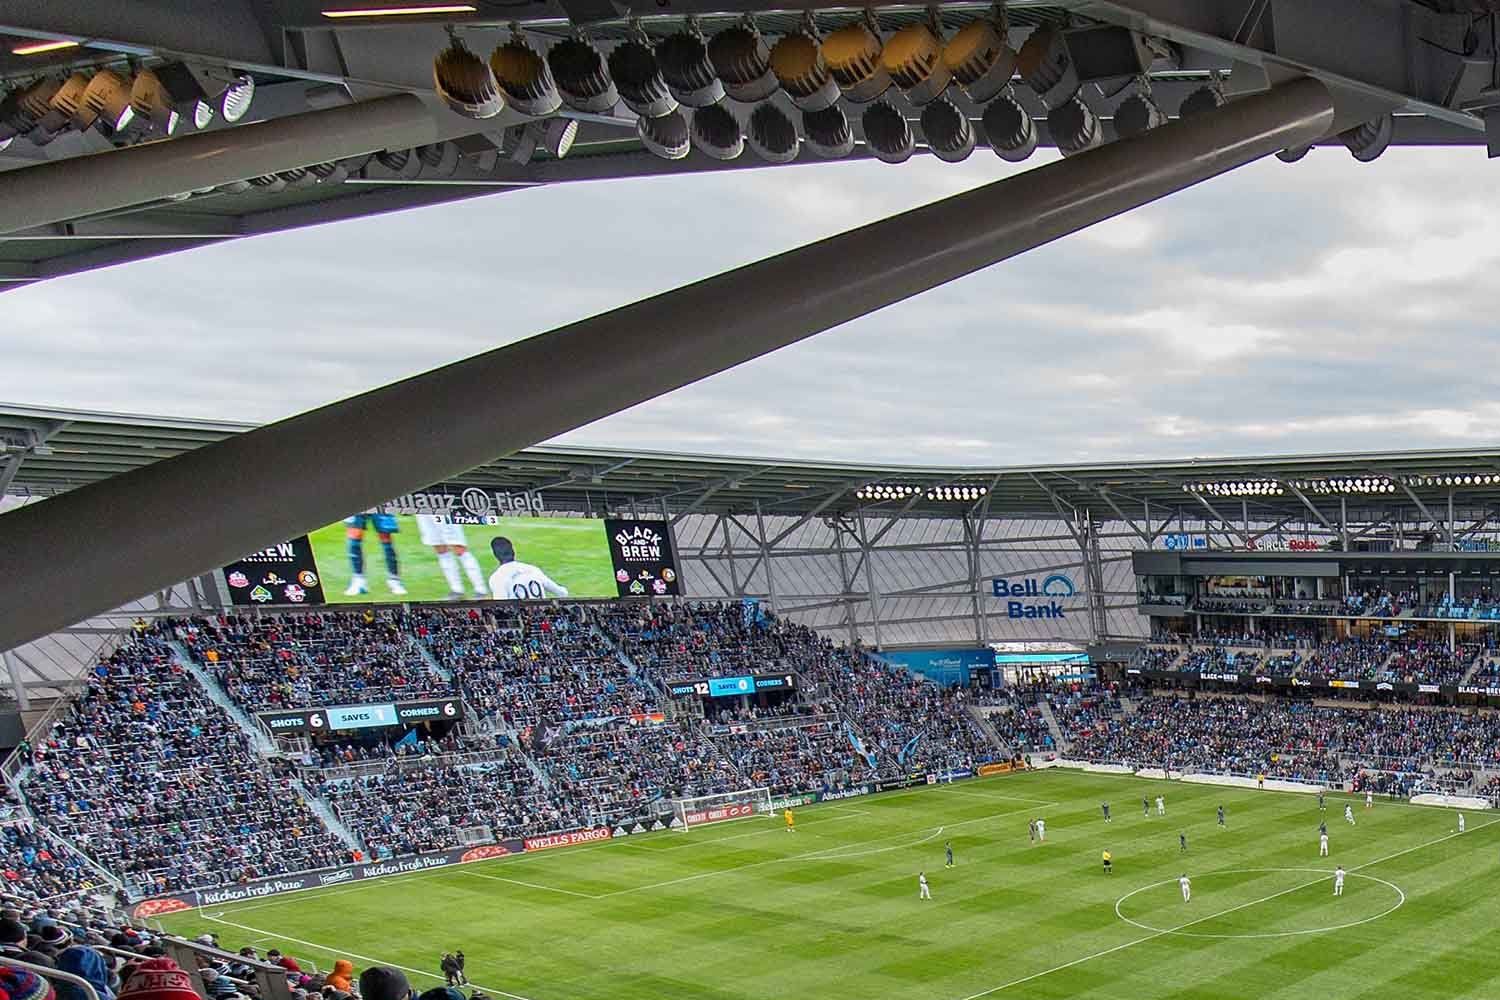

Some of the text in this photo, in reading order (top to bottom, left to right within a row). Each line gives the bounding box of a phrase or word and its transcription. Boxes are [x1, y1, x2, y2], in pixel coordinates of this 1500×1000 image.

[495, 492, 544, 511] Field
[616, 526, 662, 546] BLACK
[621, 545, 662, 557] BREW
[992, 578, 1037, 598] Bell
[1007, 601, 1064, 619] Bank
[672, 682, 710, 695] SHOTS 12
[785, 675, 793, 686] 1
[1458, 686, 1479, 694] BLACK
[400, 702, 456, 718] CORNERS 6
[270, 714, 324, 728] SHOTS 6
[341, 714, 370, 723] SAVES
[757, 797, 803, 812] Heineken
[527, 827, 609, 850] WELLS FARGO
[363, 855, 446, 877] Kitchen Fresh Pizza
[204, 879, 303, 904] Kitchen Fresh Pizza
